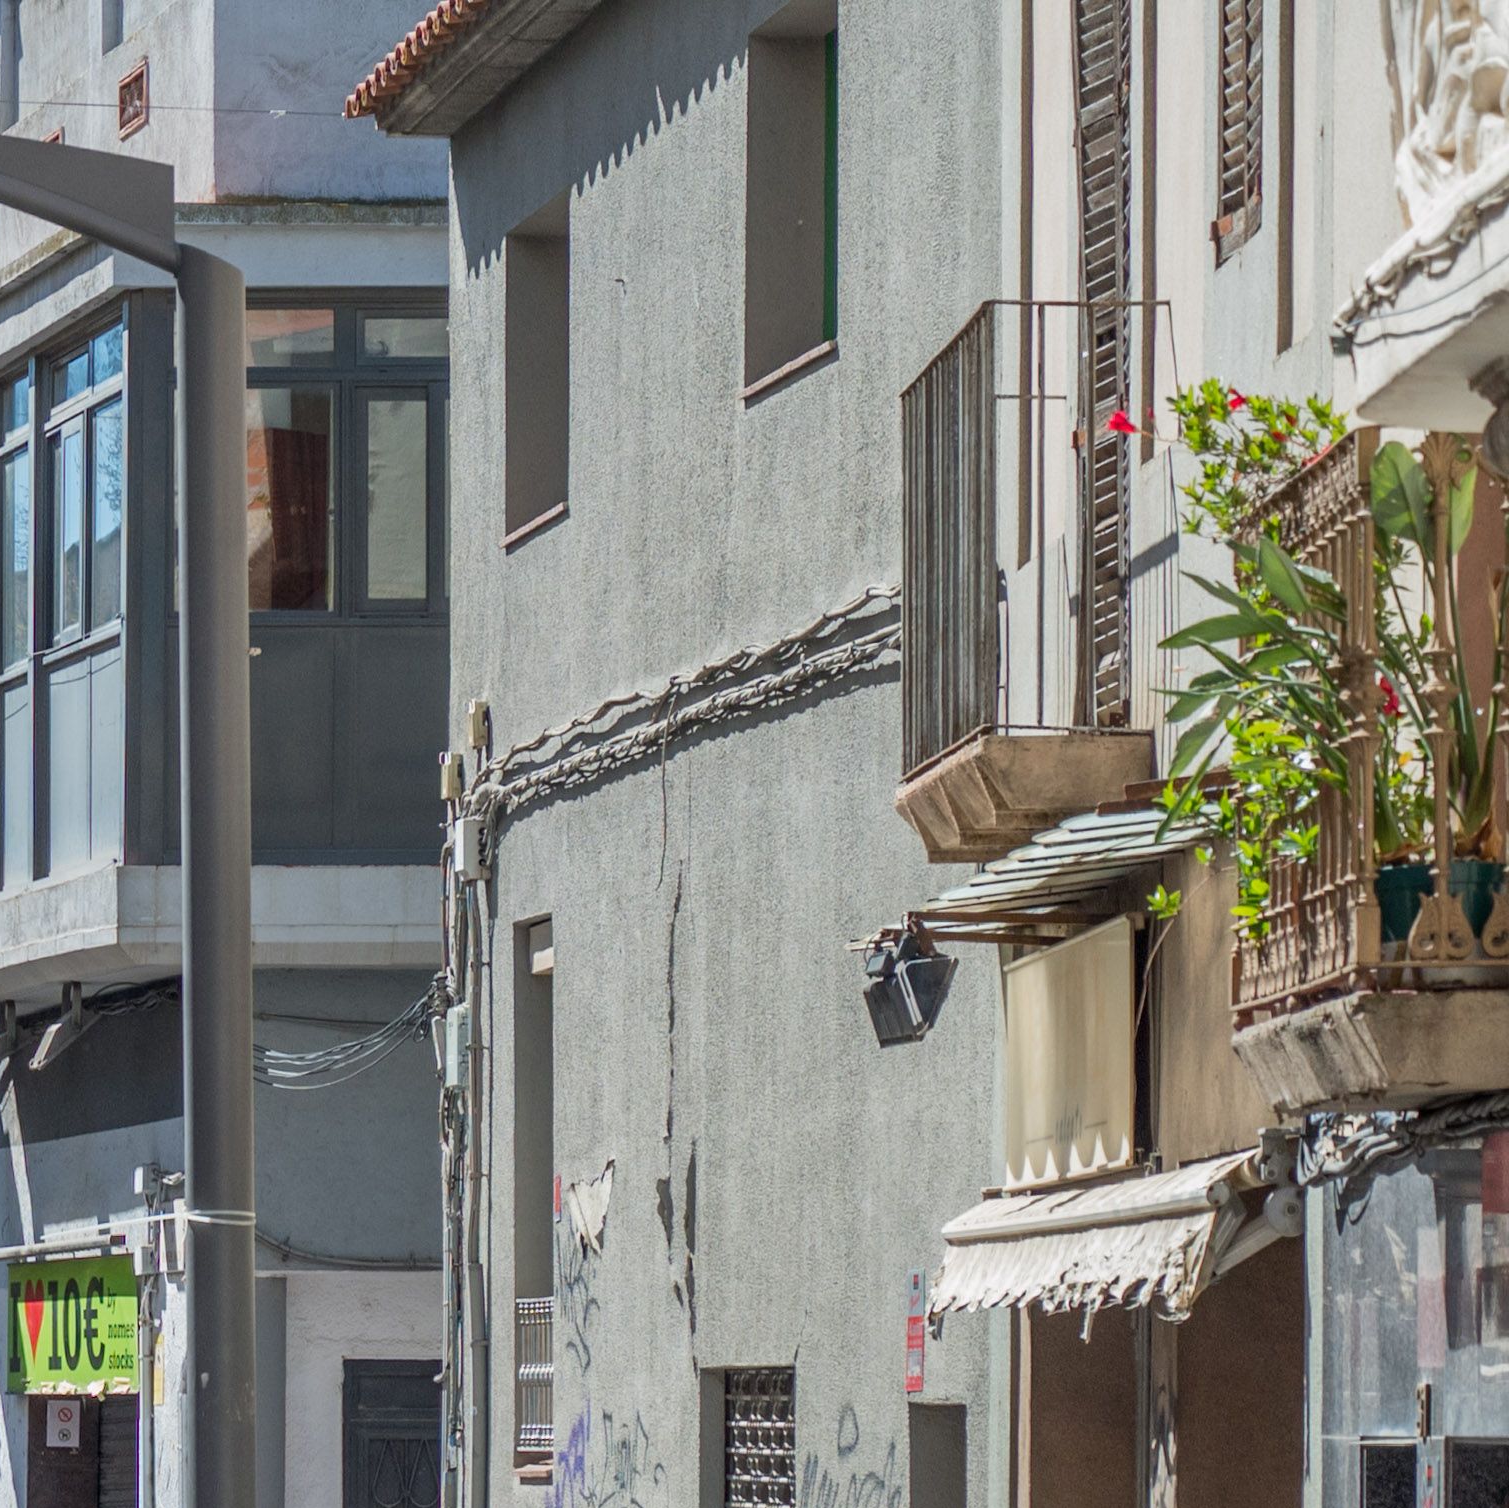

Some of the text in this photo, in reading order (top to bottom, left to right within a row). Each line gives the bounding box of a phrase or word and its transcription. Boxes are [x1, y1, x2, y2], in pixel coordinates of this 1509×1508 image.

[10, 1276, 106, 1373] I 10€
[109, 1348, 134, 1371] stocks
